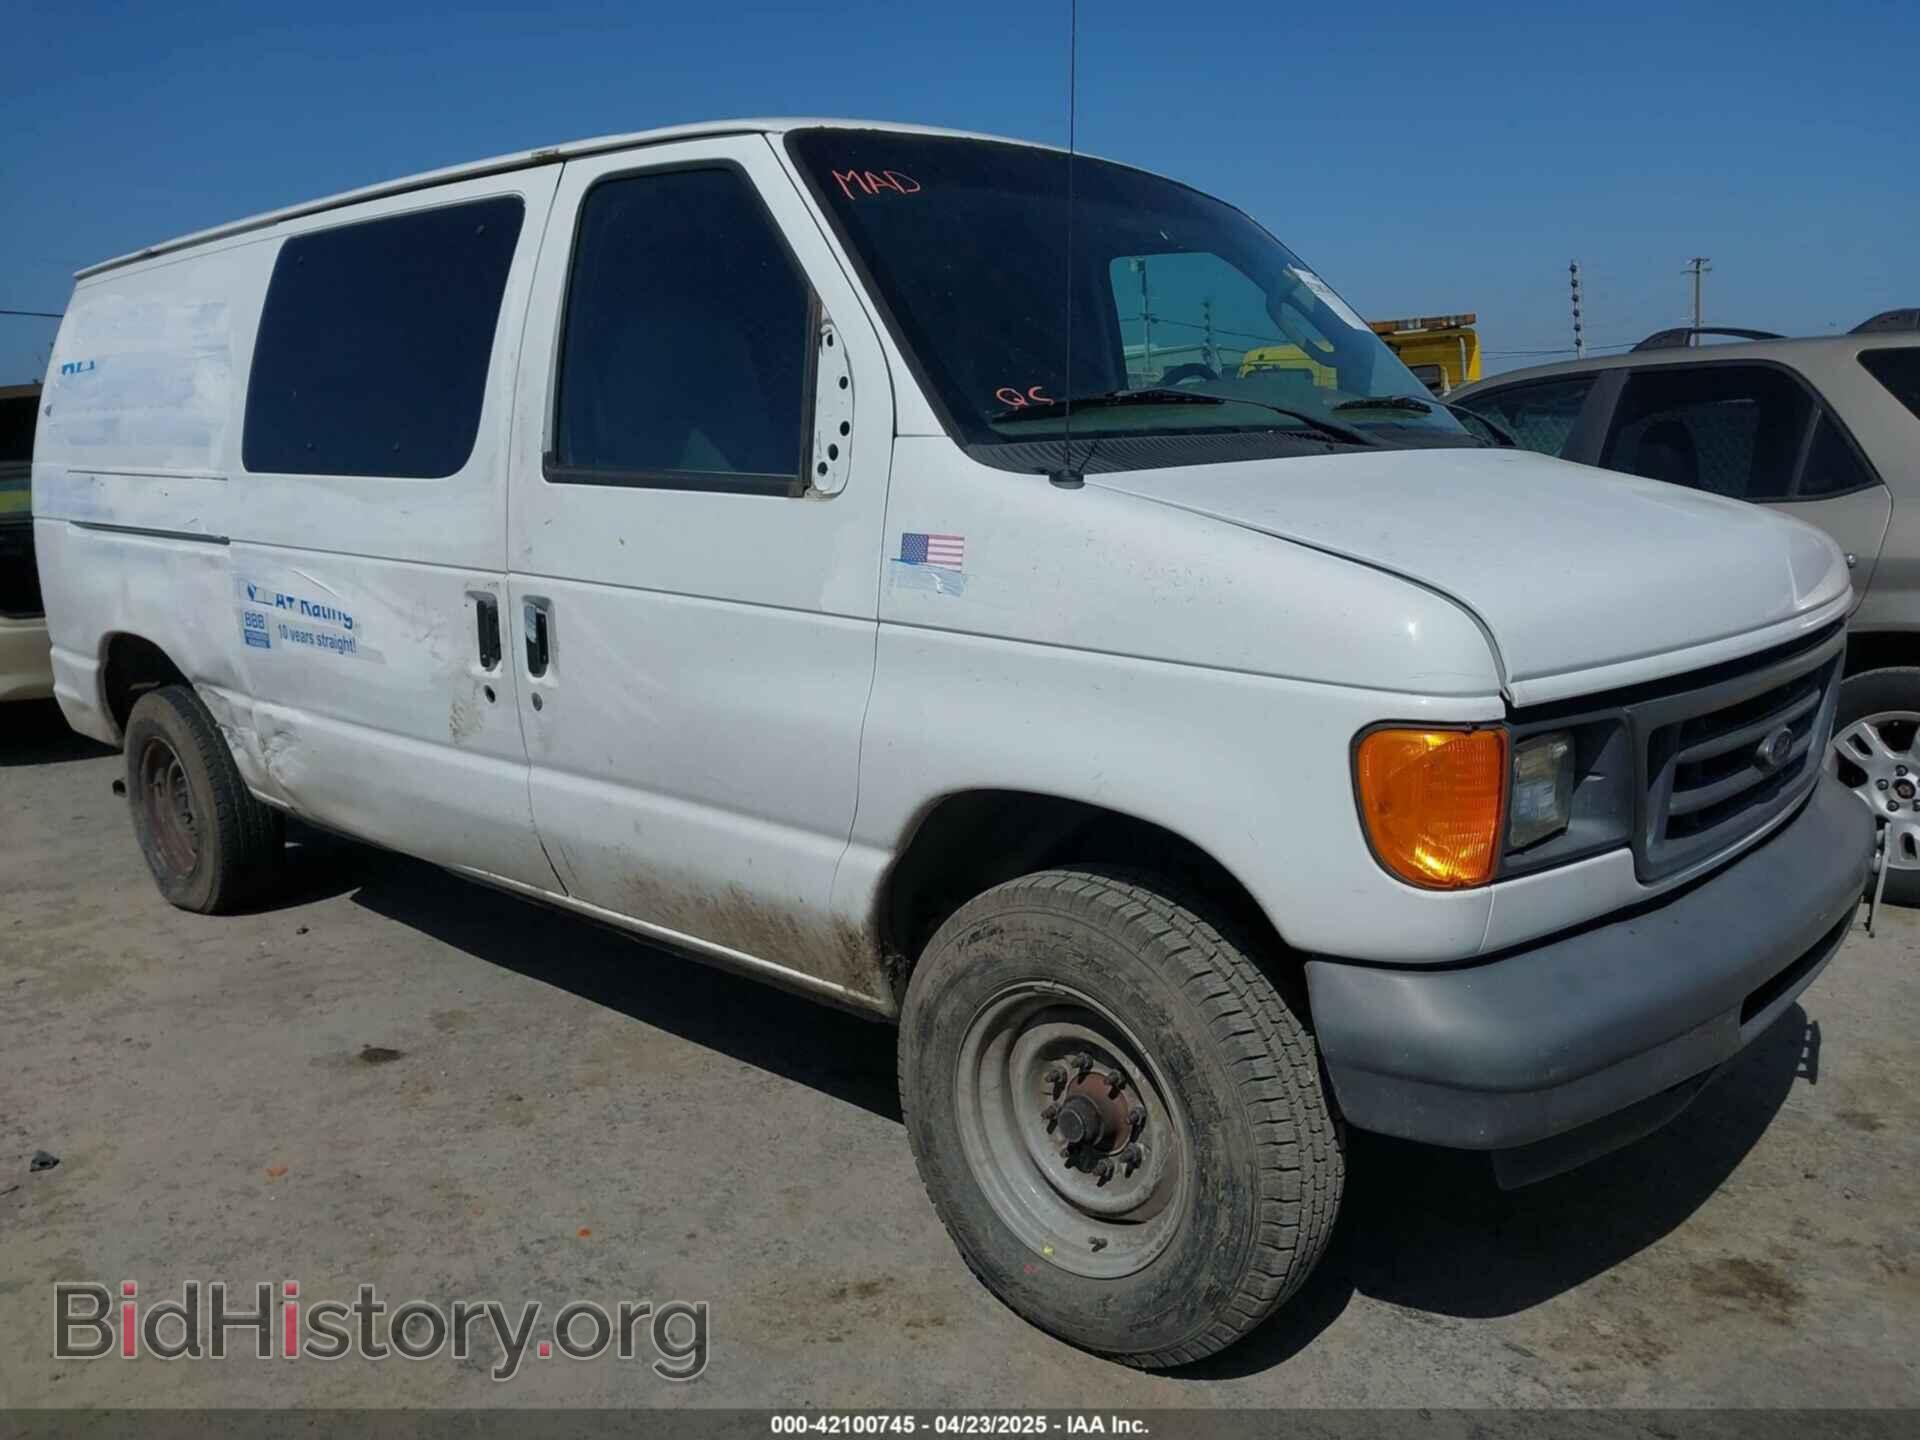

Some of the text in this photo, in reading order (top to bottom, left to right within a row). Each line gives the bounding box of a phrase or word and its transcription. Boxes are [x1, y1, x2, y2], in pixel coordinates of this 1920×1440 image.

[831, 170, 921, 200] MAD
[278, 623, 289, 640] 10
[290, 629, 314, 644] years
[316, 633, 357, 655] straight!
